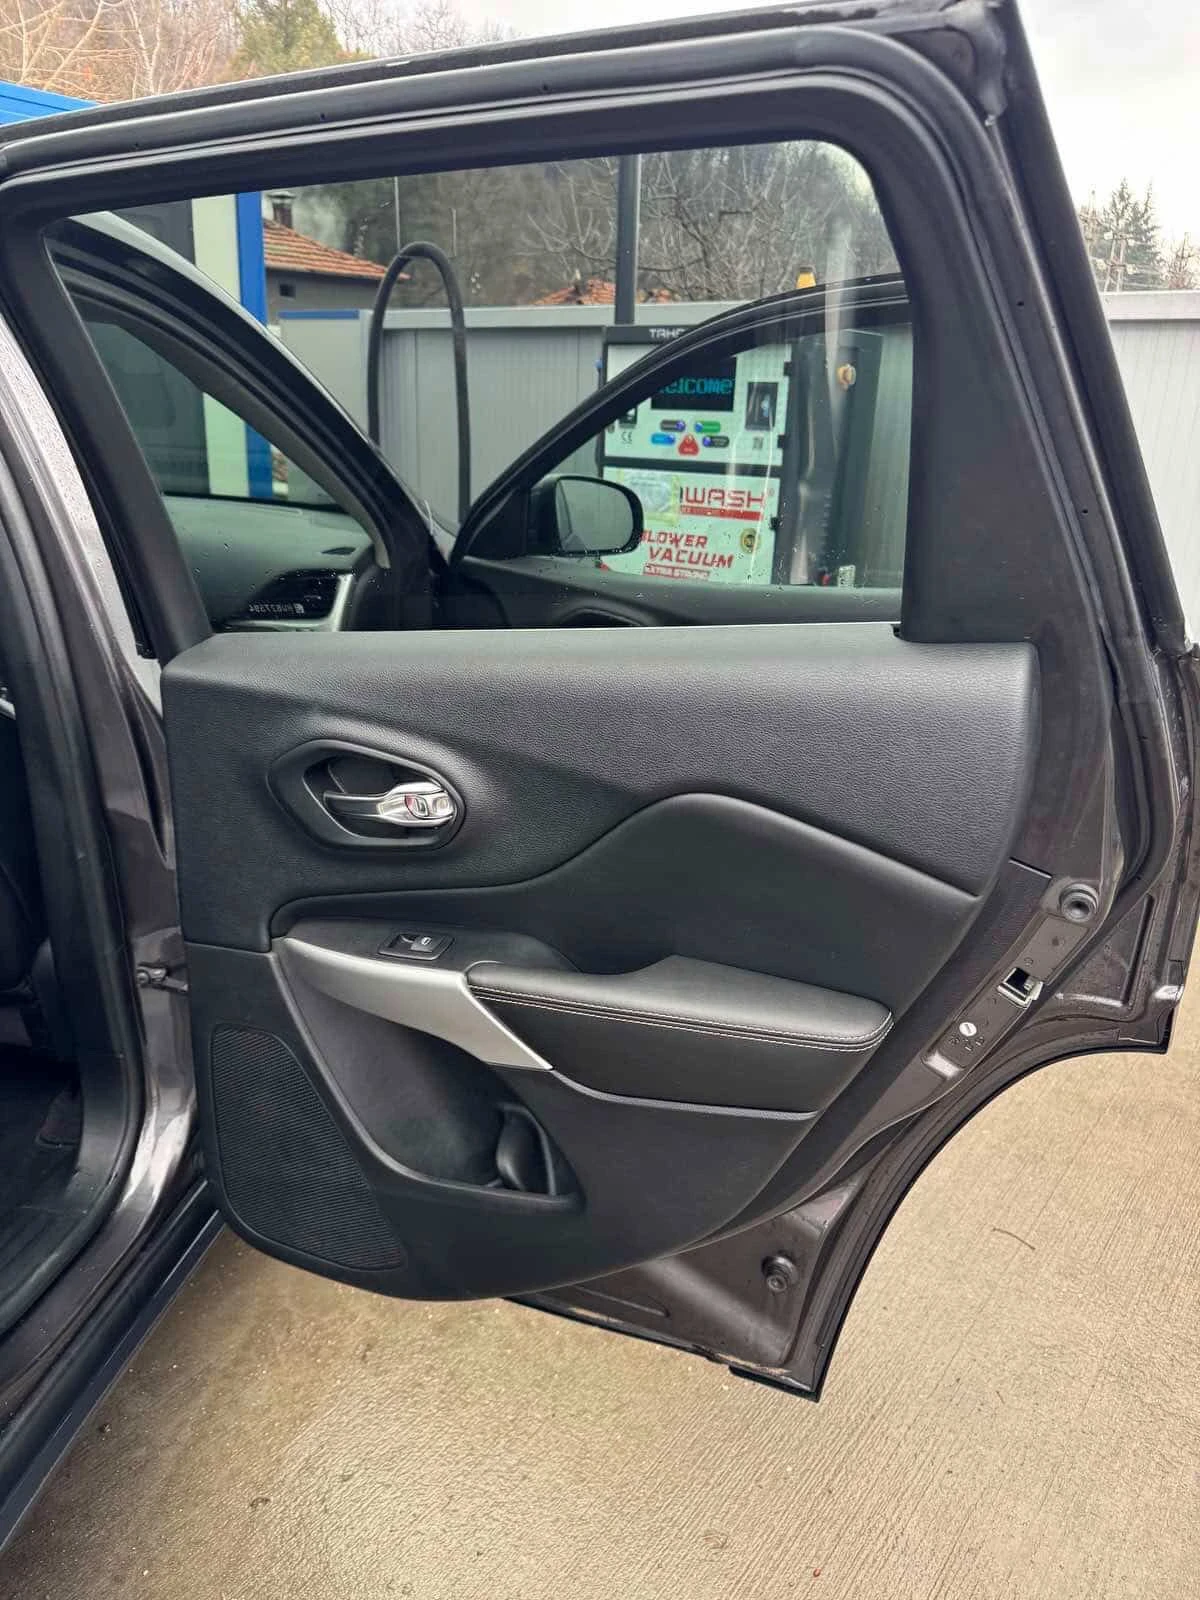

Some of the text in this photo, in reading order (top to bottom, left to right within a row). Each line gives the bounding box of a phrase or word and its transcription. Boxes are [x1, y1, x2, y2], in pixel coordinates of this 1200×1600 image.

[660, 377, 733, 395] elcome
[680, 486, 765, 508] WASH
[649, 546, 735, 569] VACUUM
